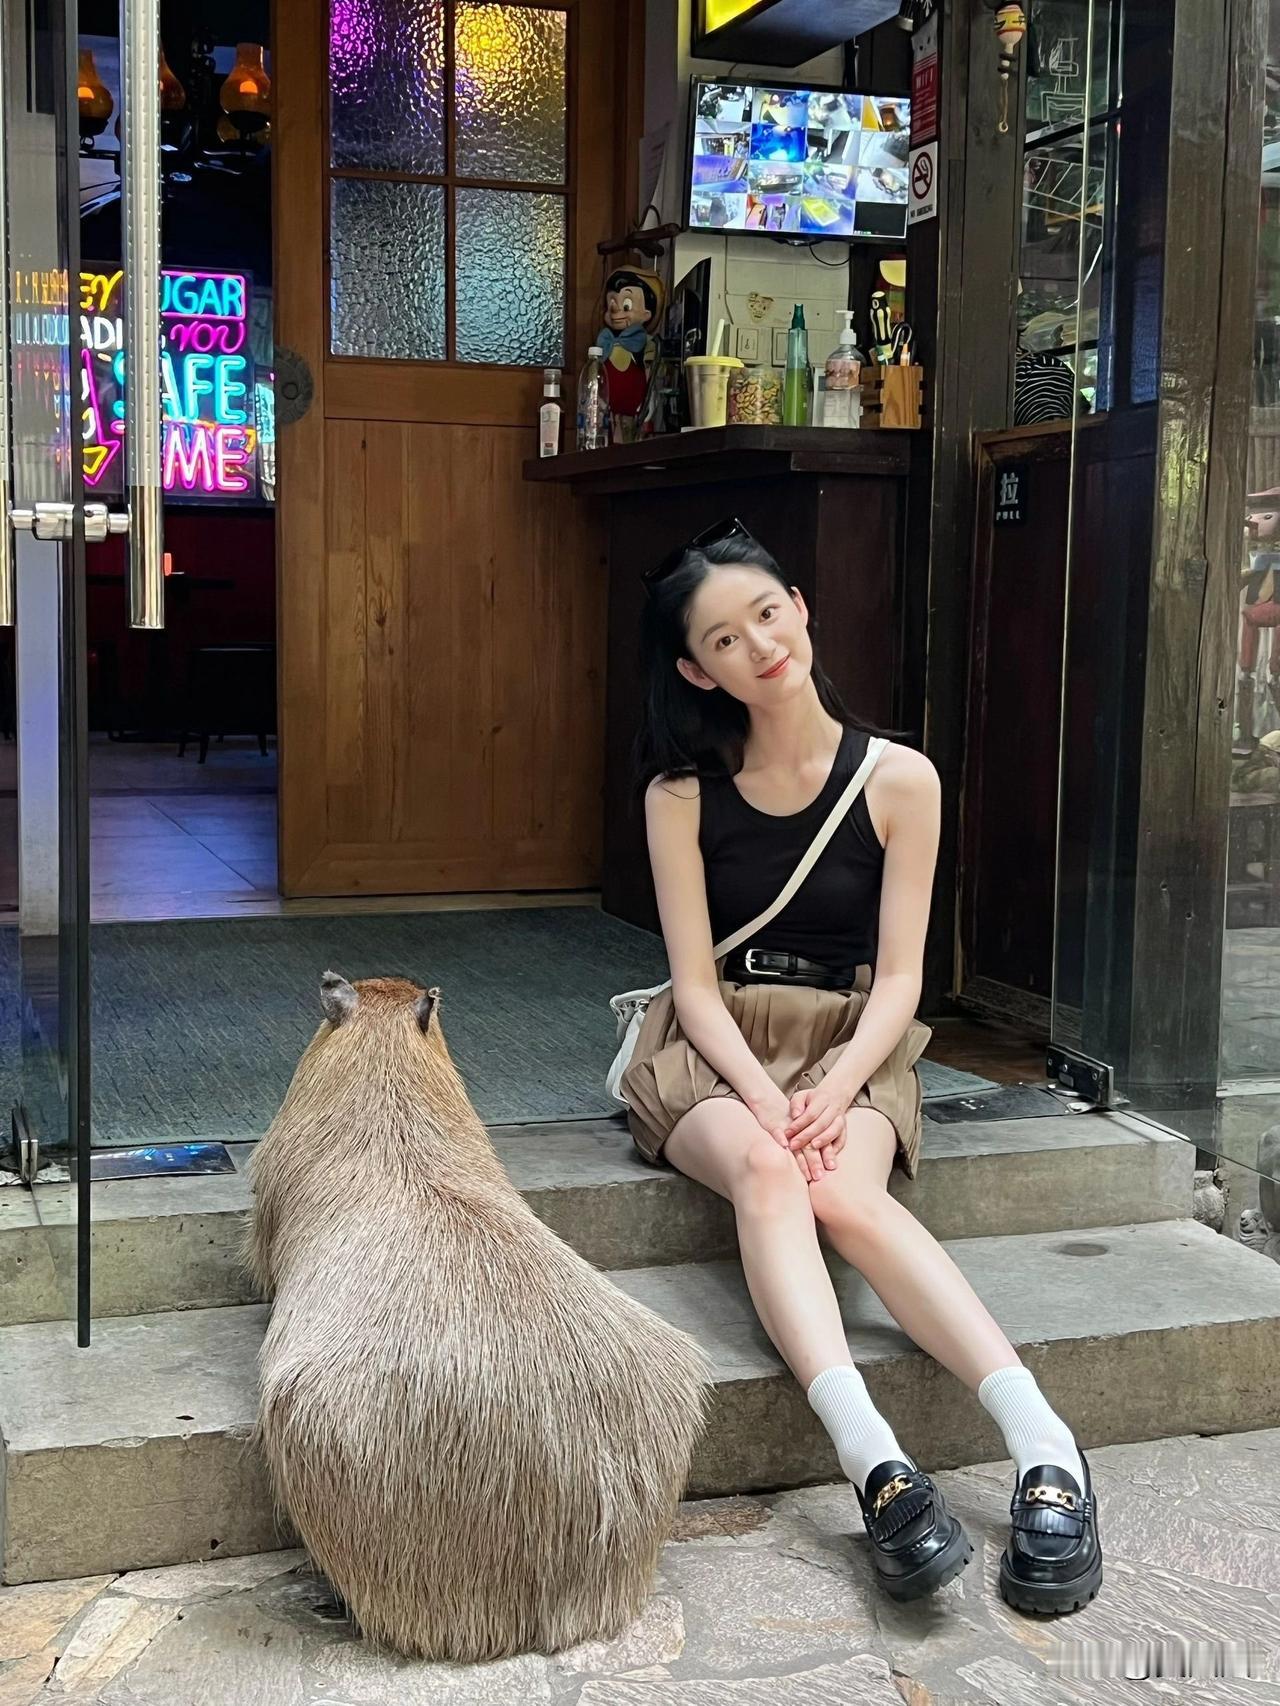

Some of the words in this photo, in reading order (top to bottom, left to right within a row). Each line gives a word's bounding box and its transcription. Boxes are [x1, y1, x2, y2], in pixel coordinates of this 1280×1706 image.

[170, 321, 244, 353] YOU
[1000, 472, 1018, 505] 拉
[996, 510, 1020, 520] PULL
